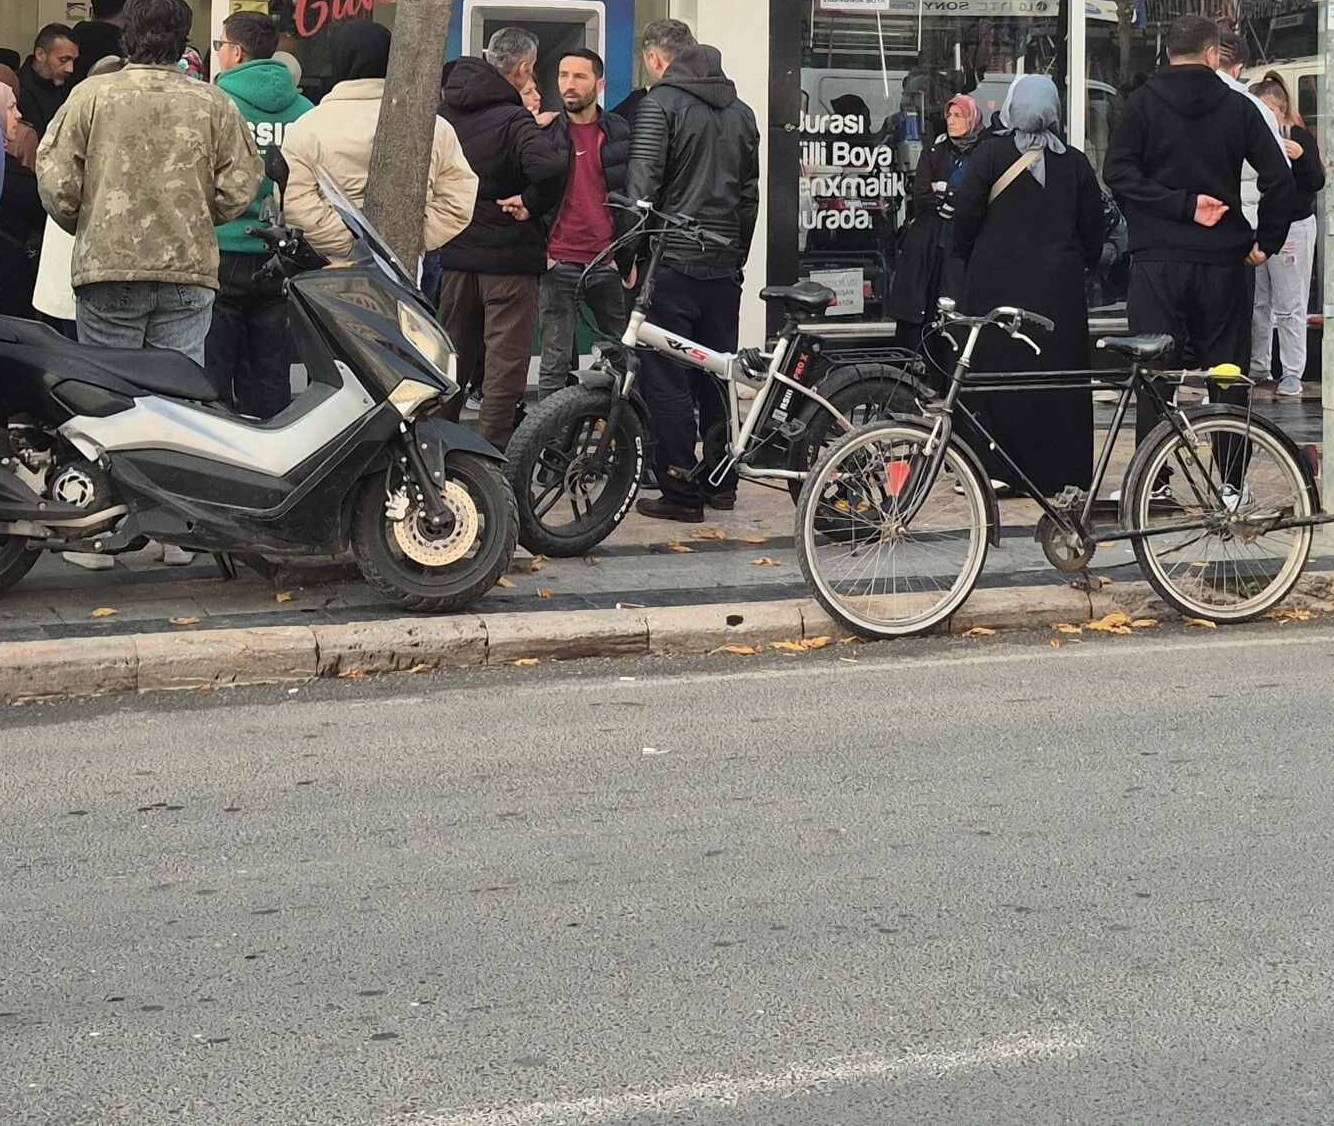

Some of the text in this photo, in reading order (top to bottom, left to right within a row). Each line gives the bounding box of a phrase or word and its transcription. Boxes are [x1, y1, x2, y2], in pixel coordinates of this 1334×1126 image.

[800, 141, 893, 173] illi Boya
[799, 172, 907, 197] enxmatik
[799, 206, 873, 230] urada.
